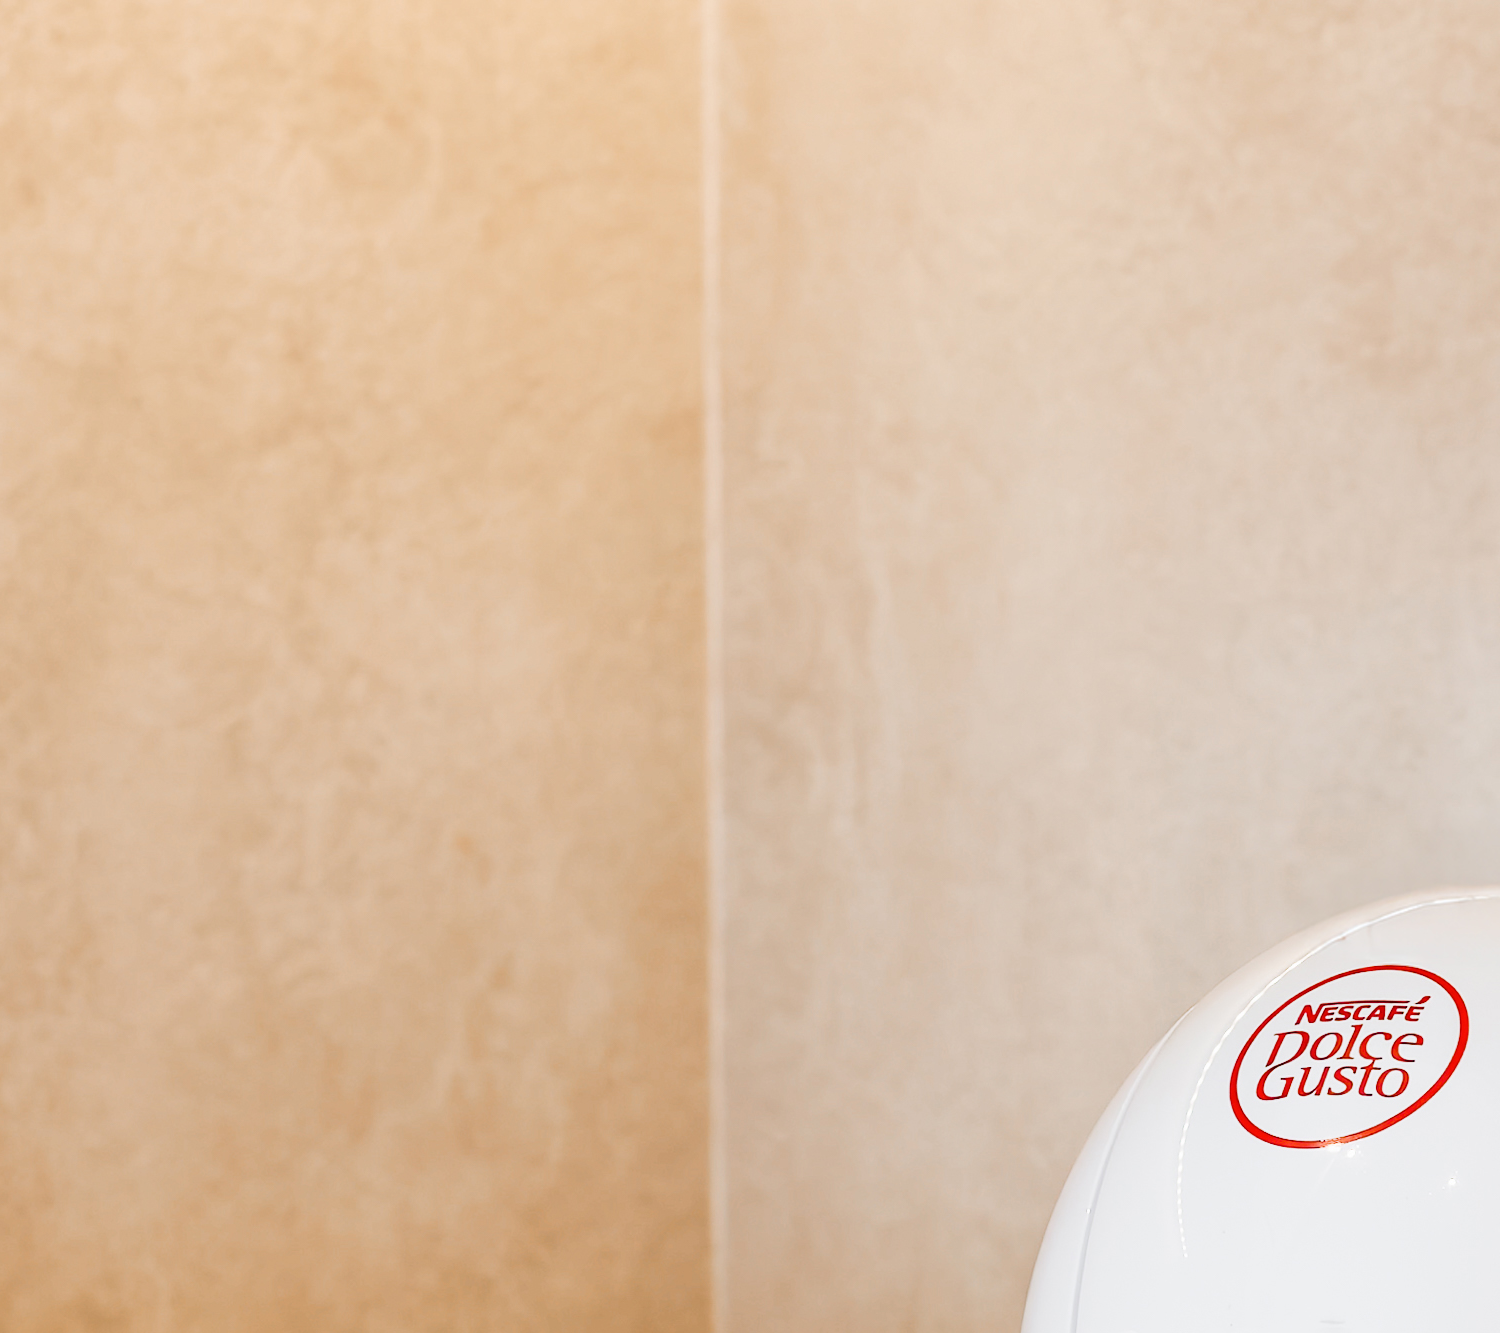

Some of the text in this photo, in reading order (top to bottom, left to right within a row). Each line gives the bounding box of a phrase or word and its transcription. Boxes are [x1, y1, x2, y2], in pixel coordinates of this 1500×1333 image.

[1295, 995, 1431, 1026] NESCAFÉ
[1265, 1024, 1424, 1068] Dolce
[1256, 1058, 1410, 1101] Gusto
